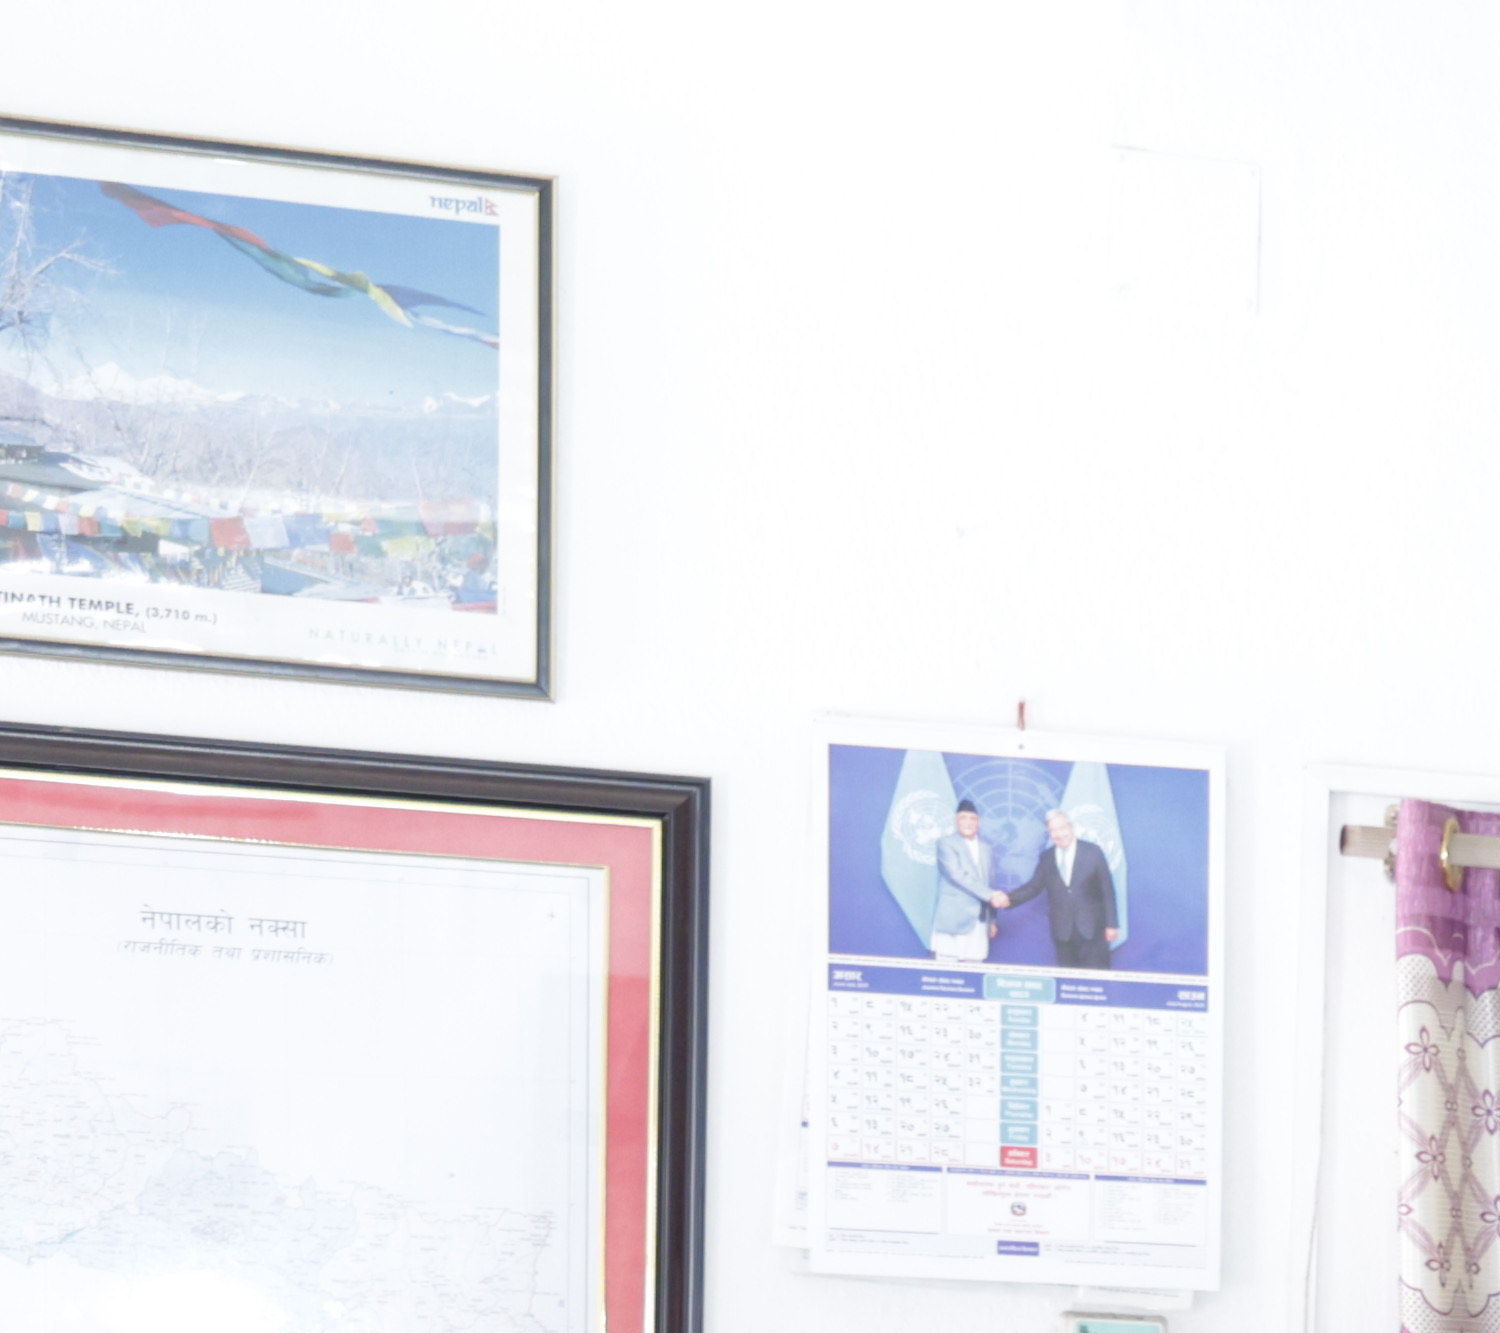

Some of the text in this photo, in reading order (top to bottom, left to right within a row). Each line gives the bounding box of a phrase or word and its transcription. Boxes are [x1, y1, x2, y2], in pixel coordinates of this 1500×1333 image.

[430, 195, 484, 216] nepal
[68, 597, 140, 617] TEMPLE,
[21, 611, 148, 634] MUSTANG, NEPAL
[138, 902, 310, 939] नेपालको नक्सा
